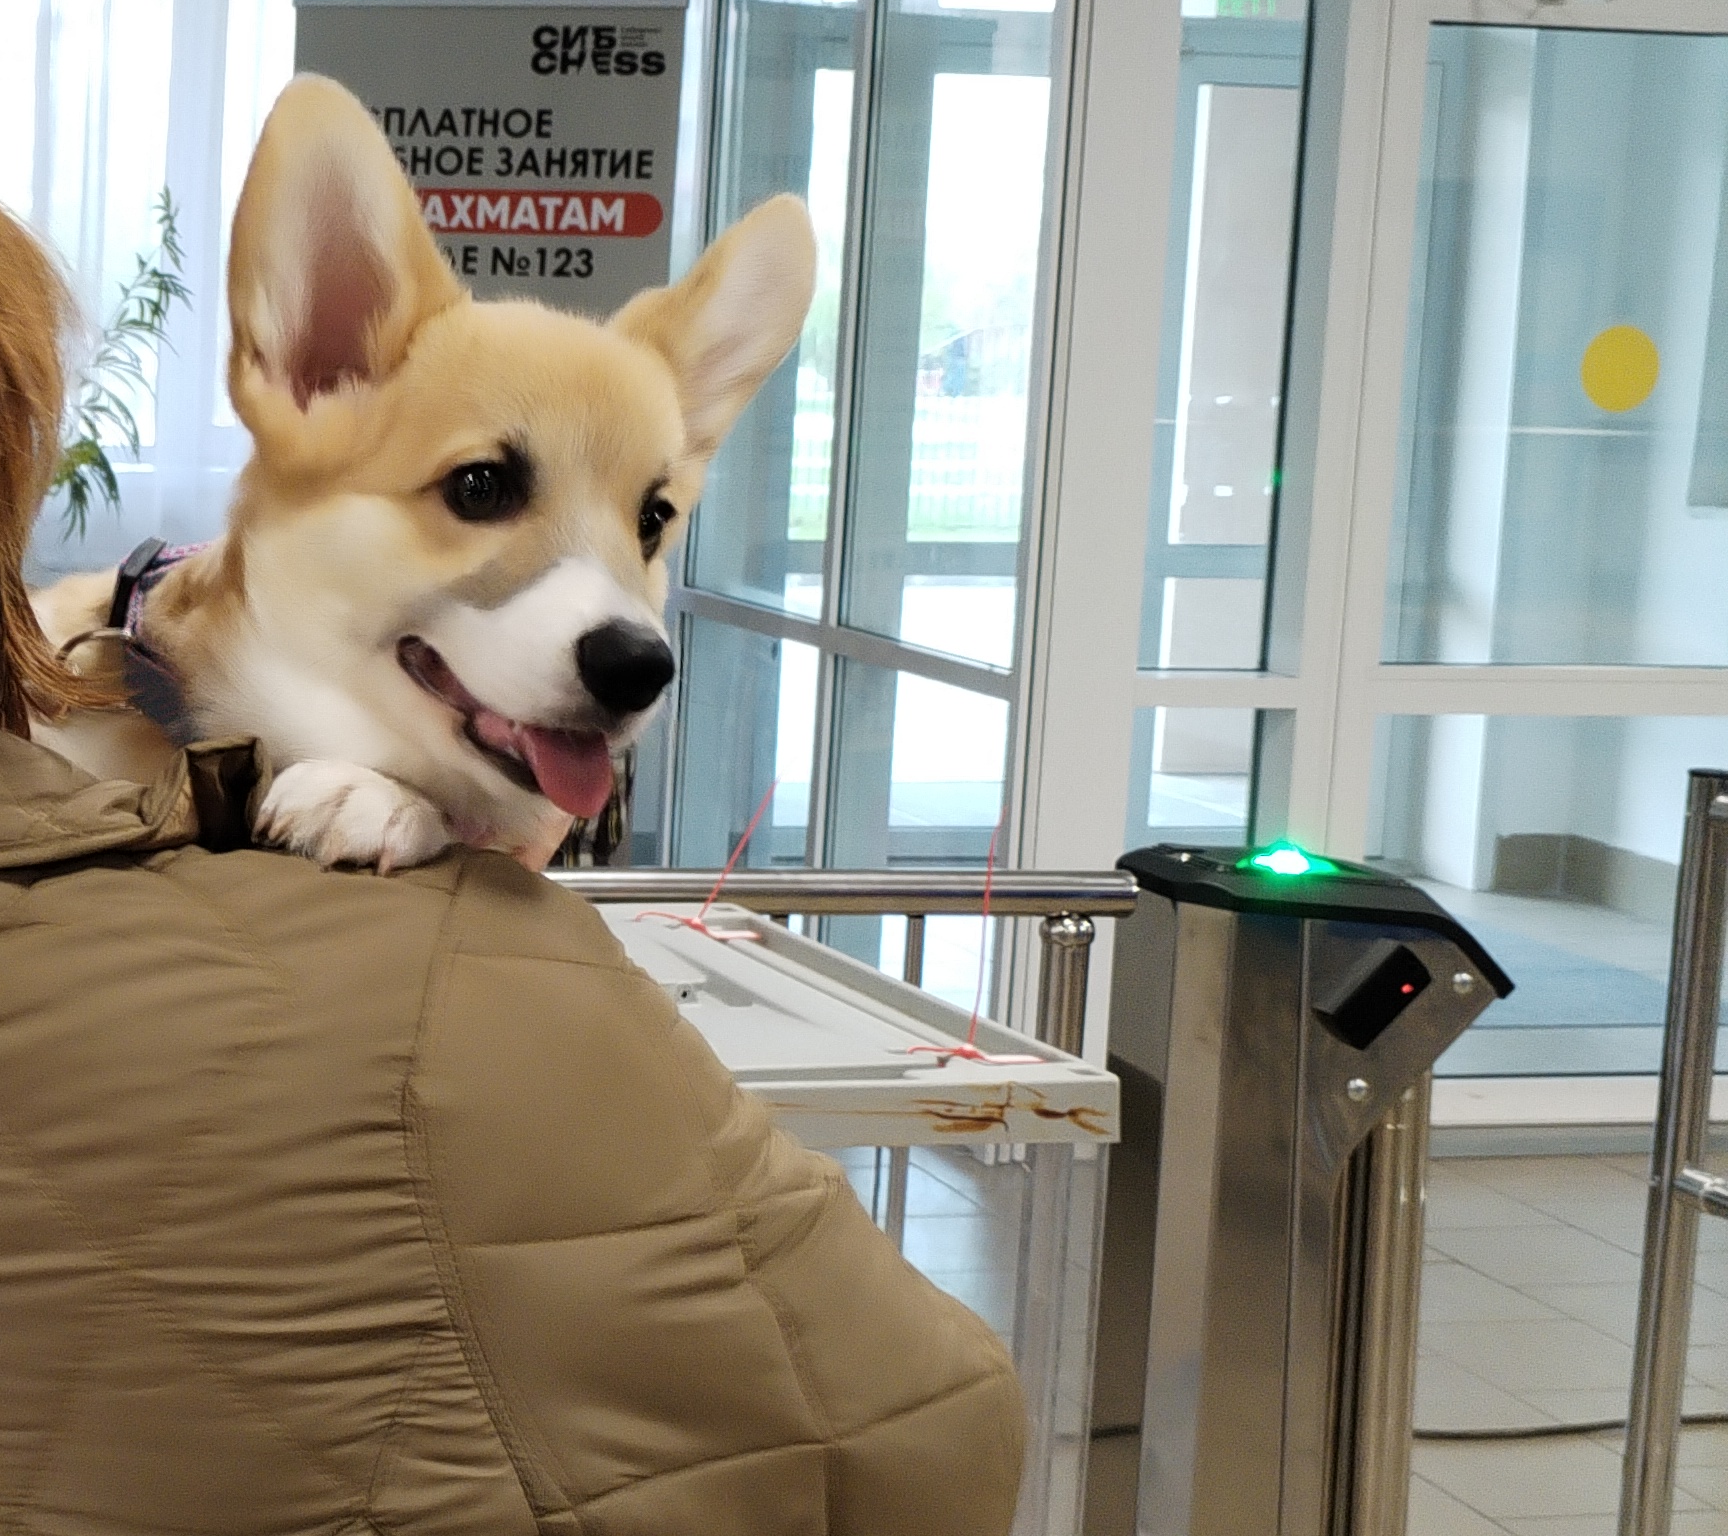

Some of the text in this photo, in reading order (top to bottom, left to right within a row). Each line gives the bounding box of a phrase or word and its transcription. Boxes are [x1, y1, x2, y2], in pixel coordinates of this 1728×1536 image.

[531, 50, 666, 76] CHESS
[371, 106, 553, 139] ПЛАТНОЕ
[494, 146, 654, 180] ЗАНЯТИЕ
[424, 194, 626, 232] АХМАТАМ
[490, 246, 594, 278] №123
